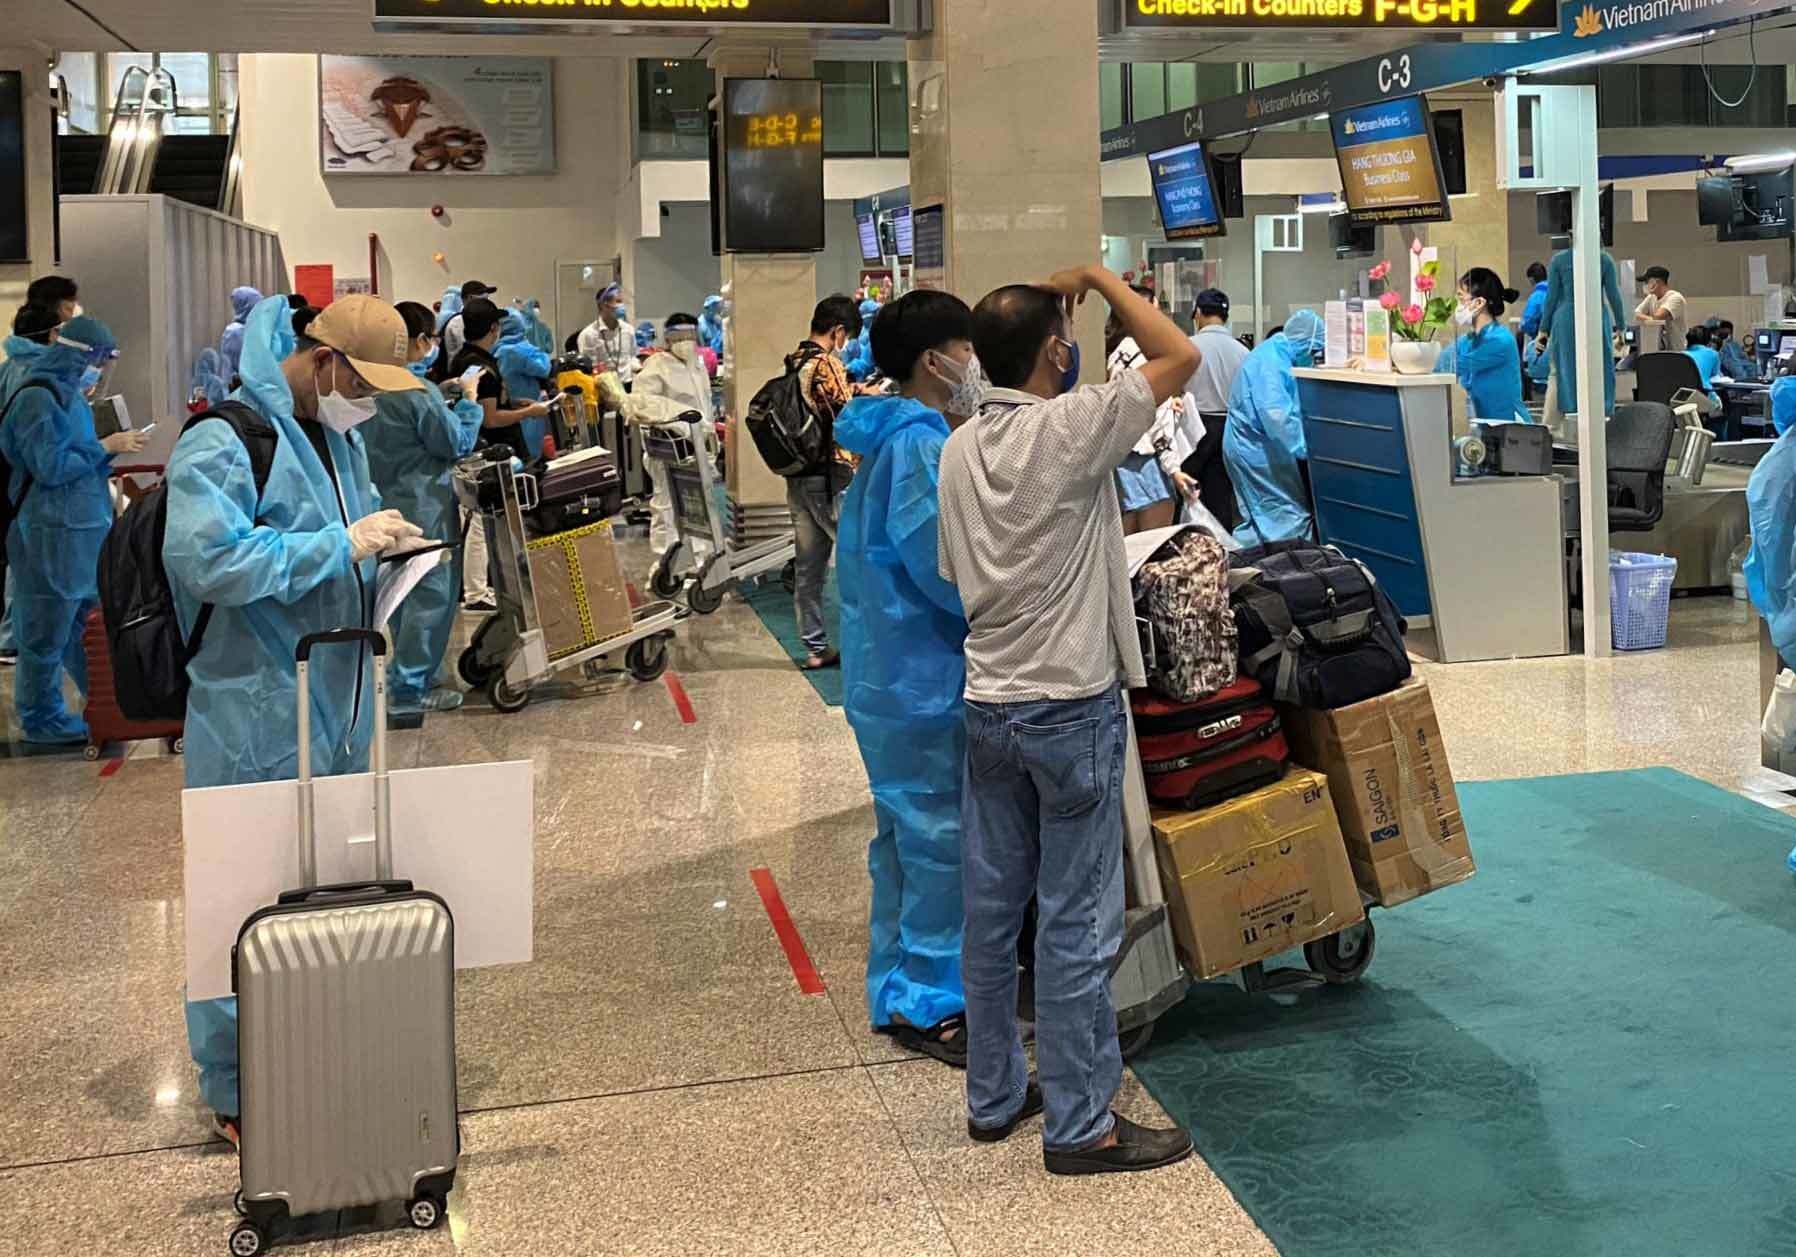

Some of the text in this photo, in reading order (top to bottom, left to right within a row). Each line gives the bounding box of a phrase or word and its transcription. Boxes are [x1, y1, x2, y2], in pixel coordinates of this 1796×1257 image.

[1137, 0, 1476, 22] Check-in Counters F-G-H
[1377, 54, 1411, 93] C-3
[1183, 107, 1204, 137] C-4
[1366, 768, 1388, 824] SAIGON
